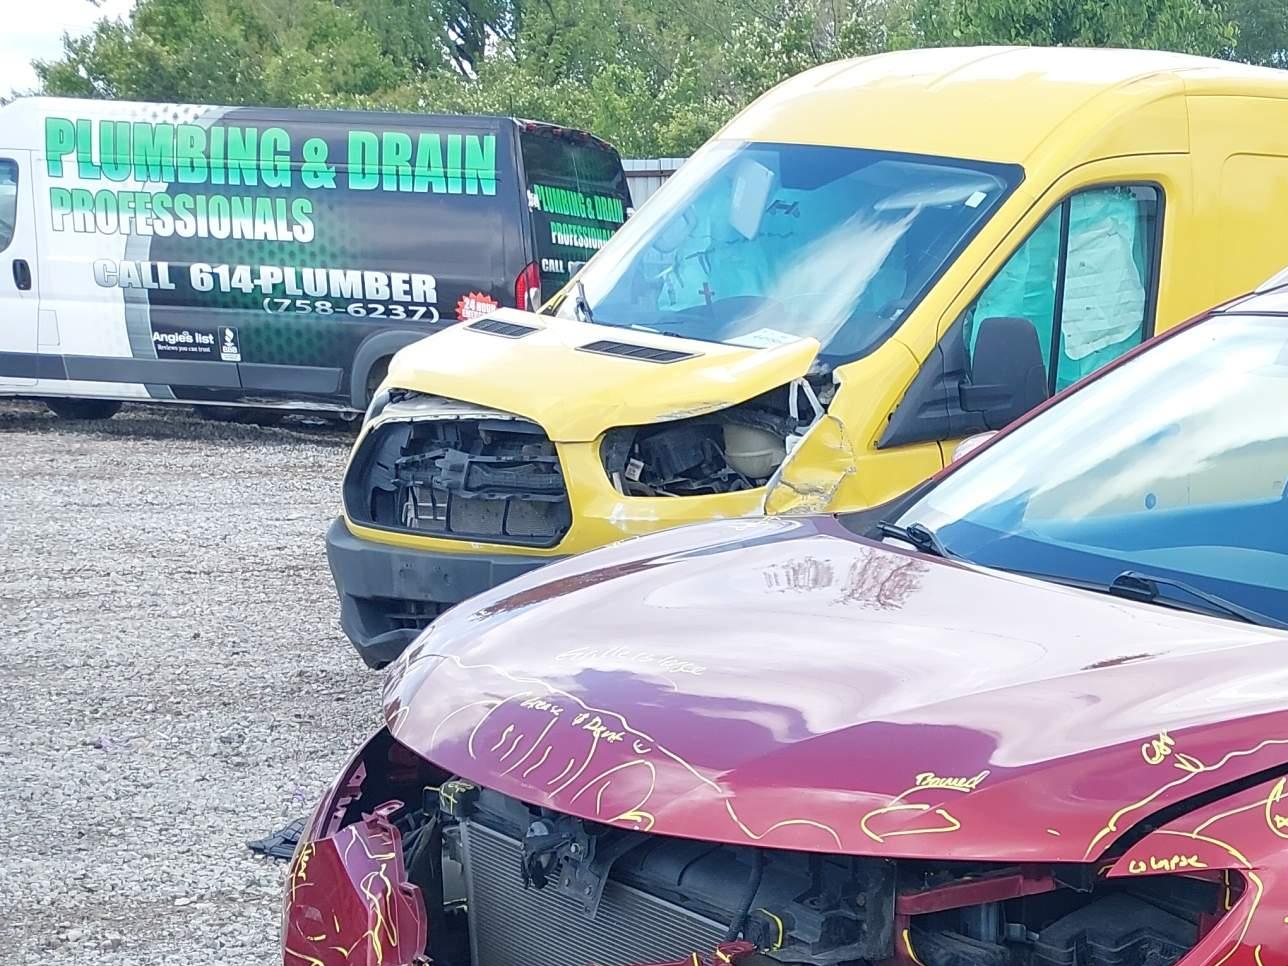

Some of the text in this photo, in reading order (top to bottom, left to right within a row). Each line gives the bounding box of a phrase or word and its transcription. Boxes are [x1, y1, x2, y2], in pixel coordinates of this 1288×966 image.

[46, 117, 497, 196] PLUMBING & DRAIN
[50, 187, 315, 243] PROFESSIONALS
[534, 184, 588, 219] PLUMBING
[594, 195, 625, 224] DRAIN
[93, 258, 438, 304] CALL 614-PLUMBER
[541, 258, 565, 273] CALL
[262, 298, 440, 324] (758-6237)
[463, 298, 476, 312] 24
[195, 332, 215, 345] list
